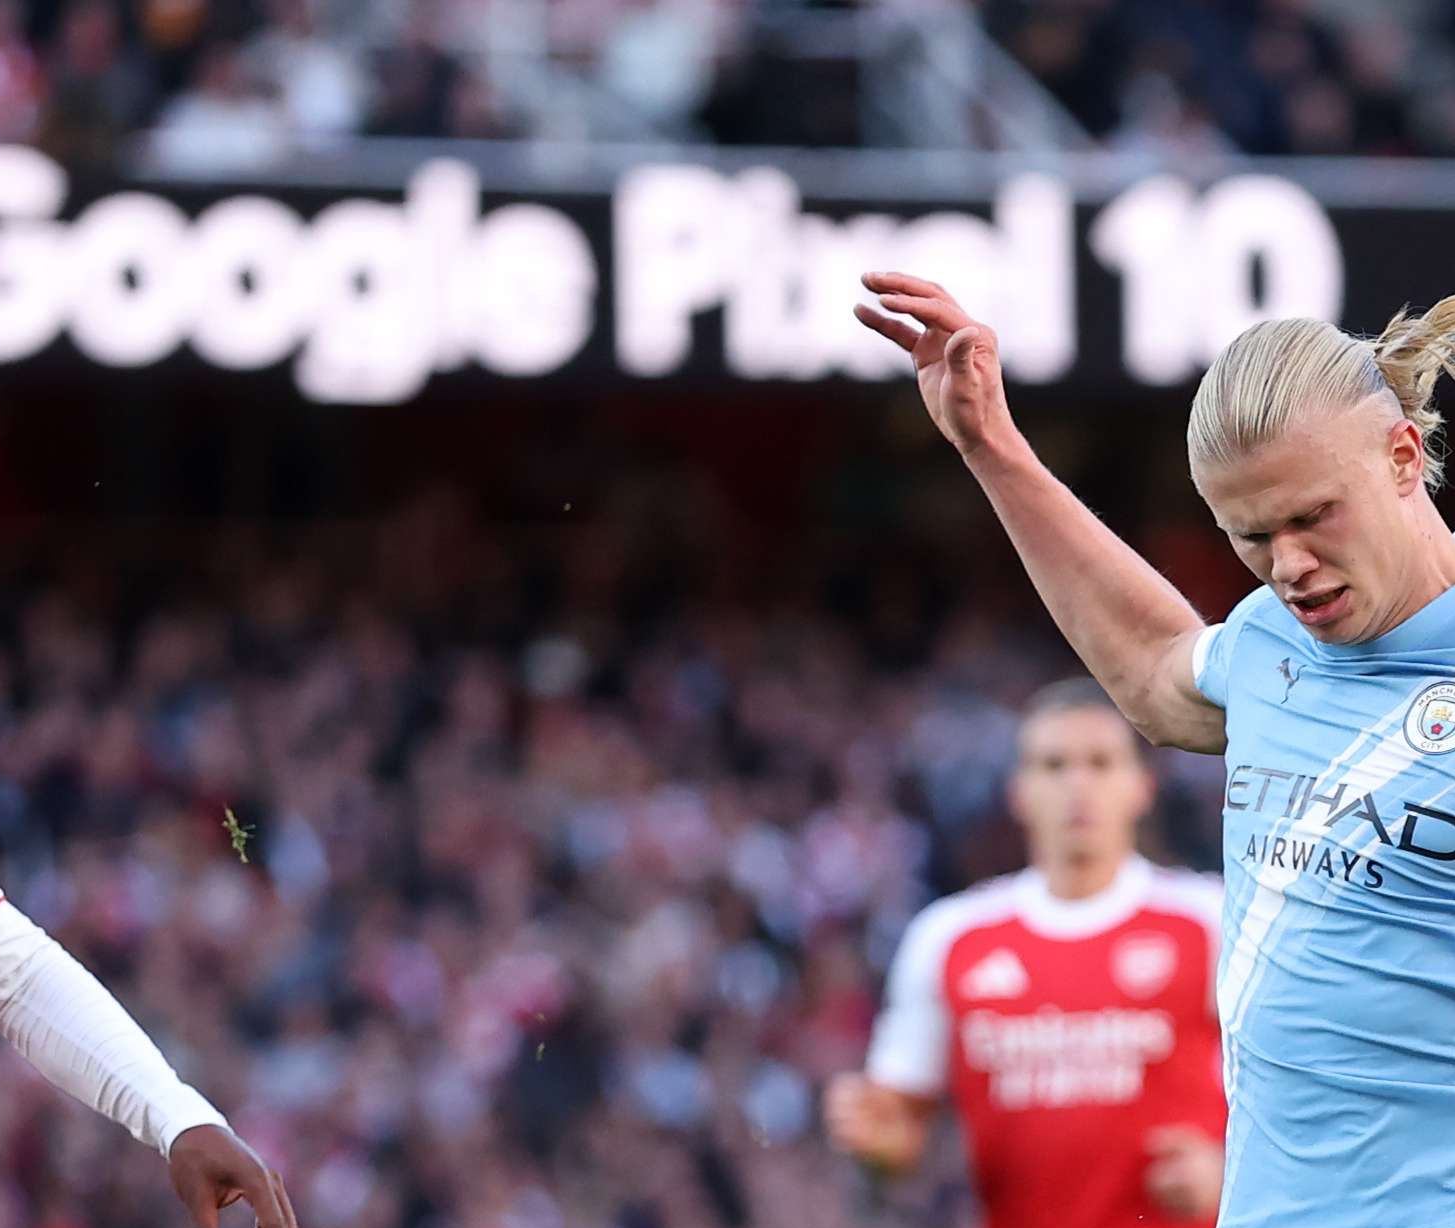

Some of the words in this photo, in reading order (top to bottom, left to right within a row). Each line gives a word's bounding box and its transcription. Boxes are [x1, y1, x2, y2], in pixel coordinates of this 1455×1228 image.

[1088, 172, 1342, 387] 10
[1420, 741, 1443, 751] CITY
[1241, 833, 1384, 889] AIRWAYS
